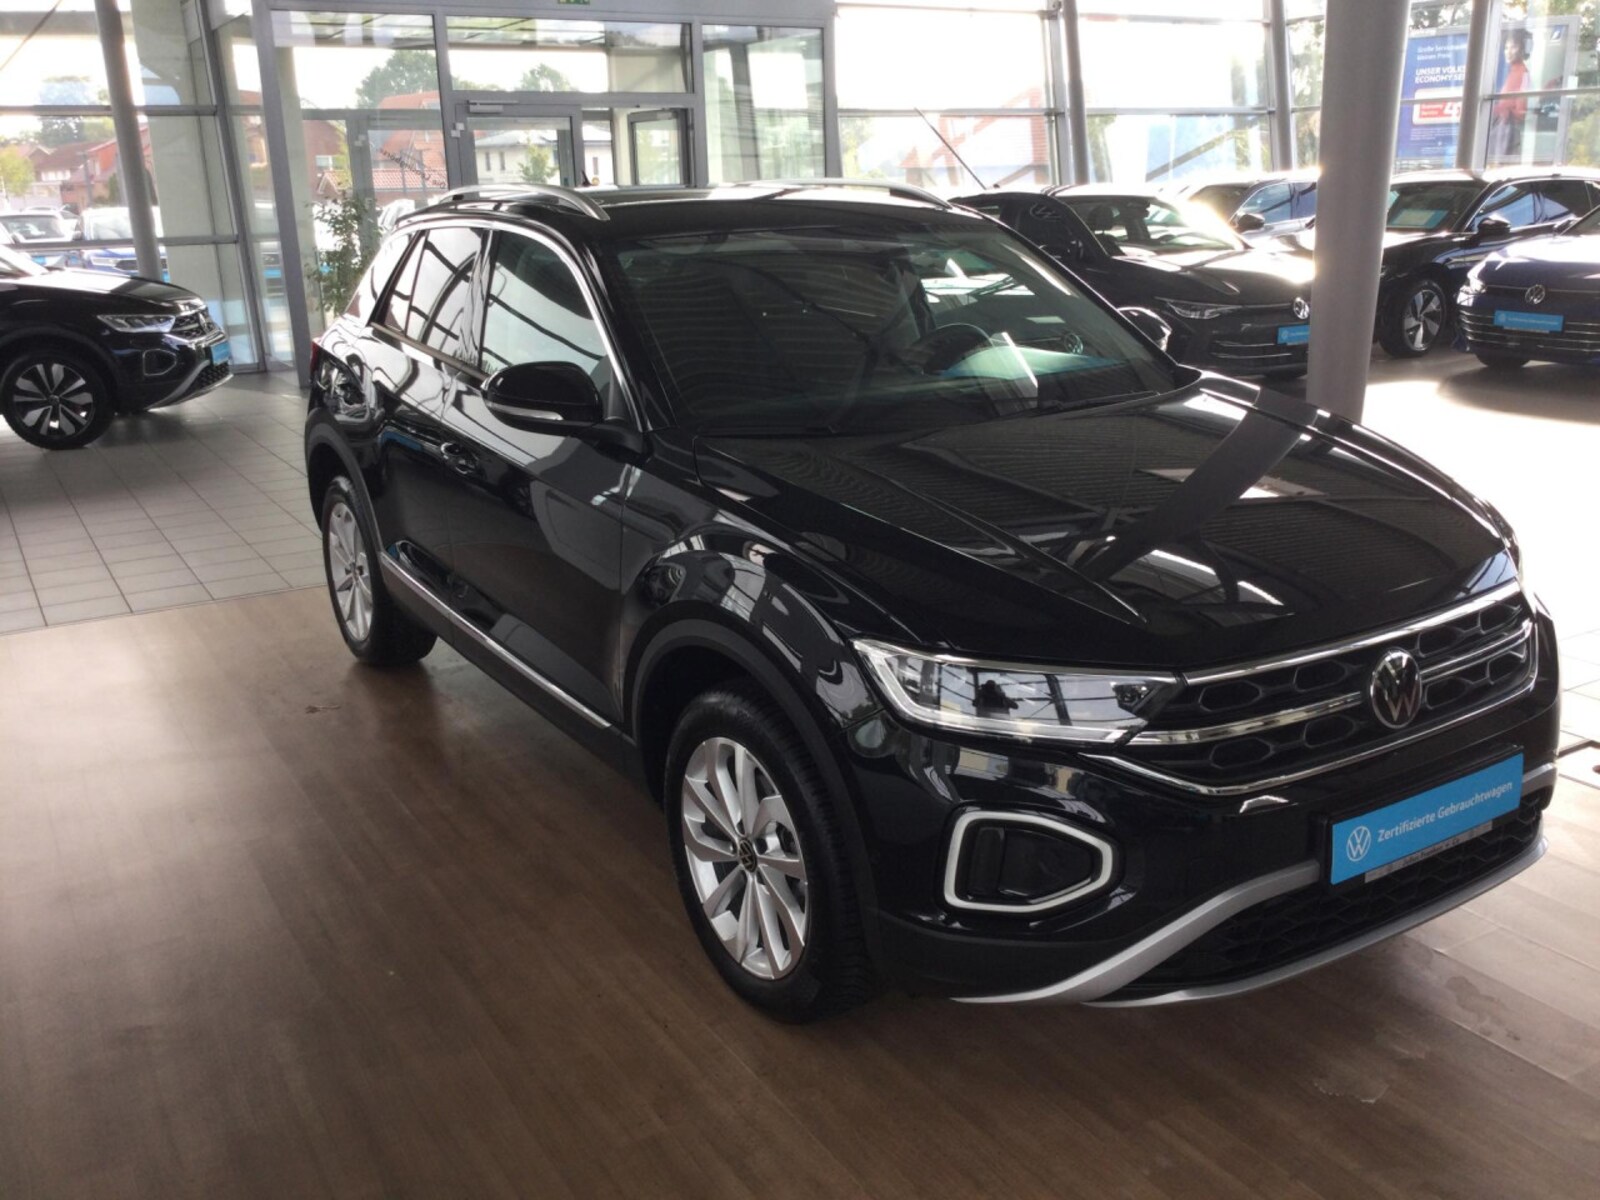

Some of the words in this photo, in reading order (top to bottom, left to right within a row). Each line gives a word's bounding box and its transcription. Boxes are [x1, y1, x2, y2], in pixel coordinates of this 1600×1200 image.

[1415, 67, 1440, 76] UNSER
[1414, 75, 1452, 84] ECONOMY
[1346, 825, 1371, 862] VW
[1377, 811, 1436, 842] Zertifizierte
[1437, 781, 1513, 819] Gebrauchtwagen
